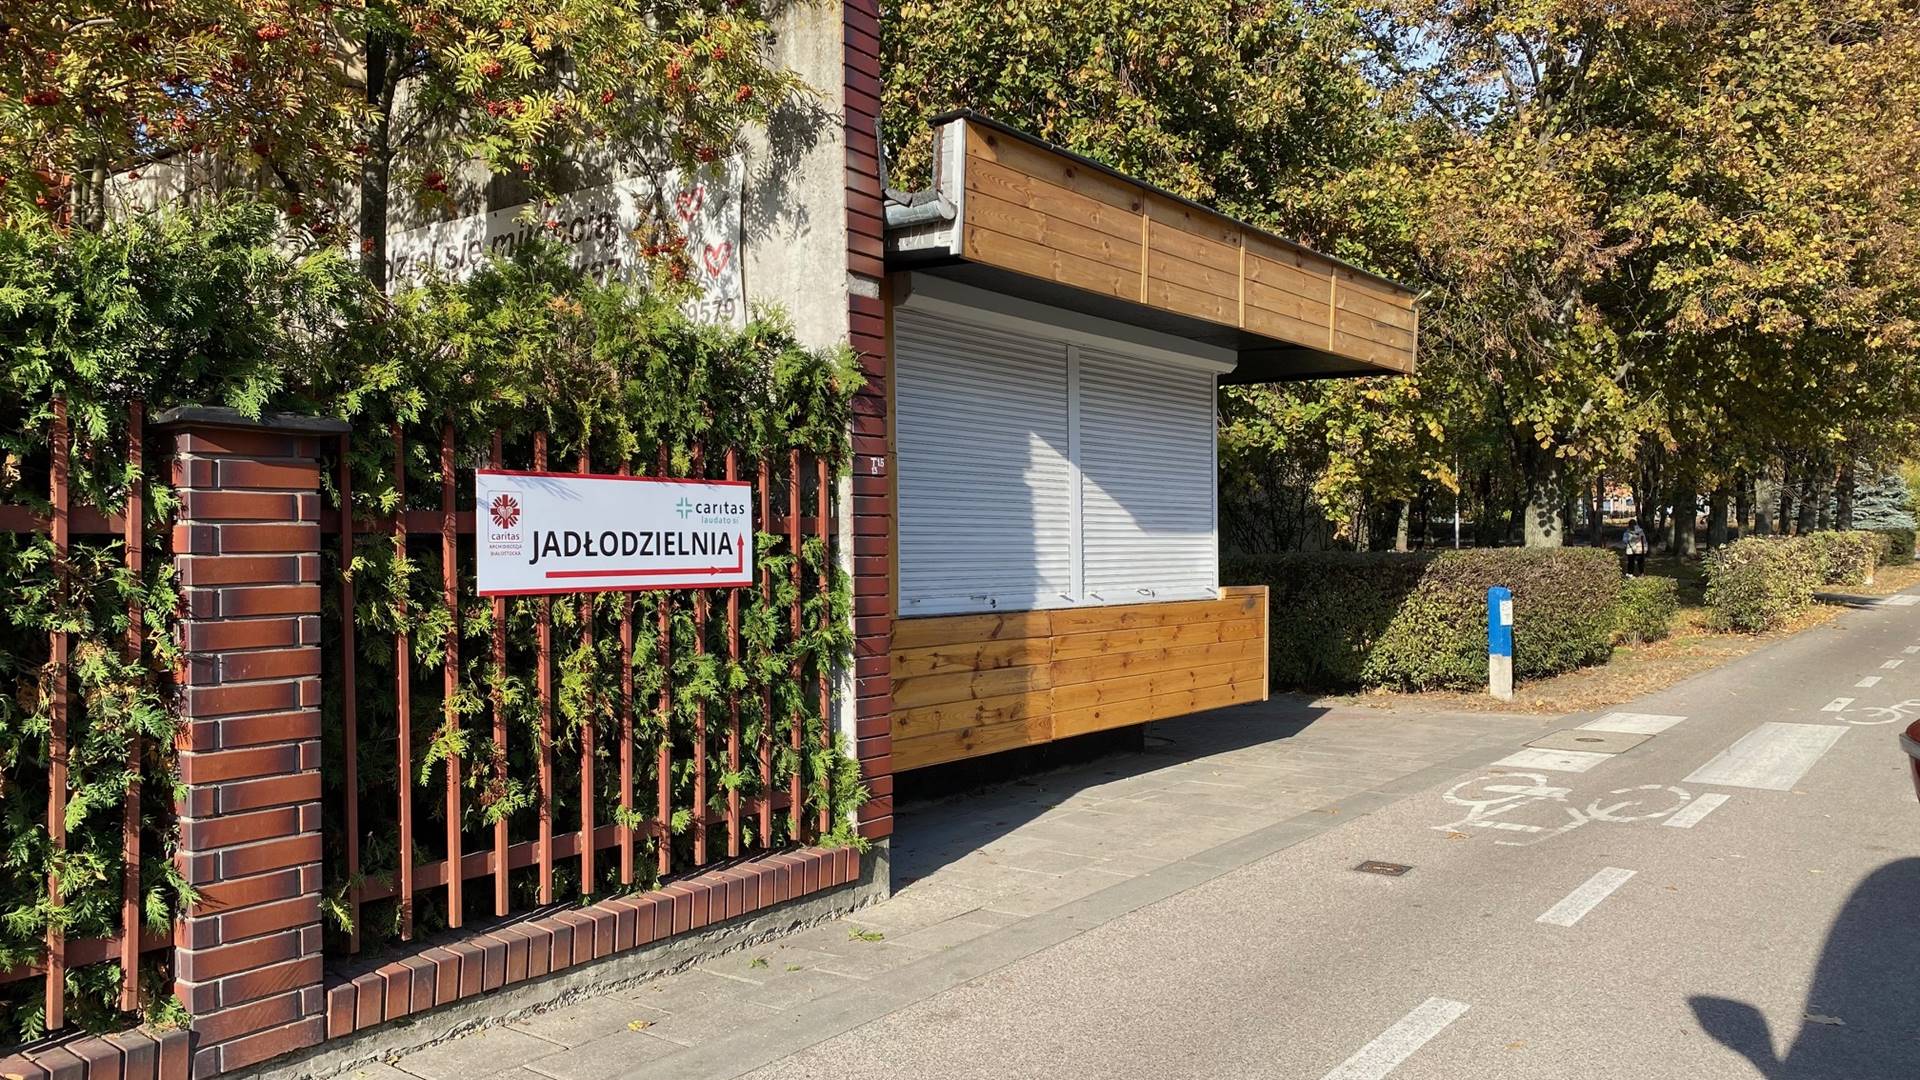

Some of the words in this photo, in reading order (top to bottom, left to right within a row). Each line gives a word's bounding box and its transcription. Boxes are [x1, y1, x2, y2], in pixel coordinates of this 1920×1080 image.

[696, 501, 745, 515] caritas
[701, 516, 731, 524] laudato
[491, 532, 520, 540] caritas
[529, 530, 733, 565] JADŁODZIELNIA
